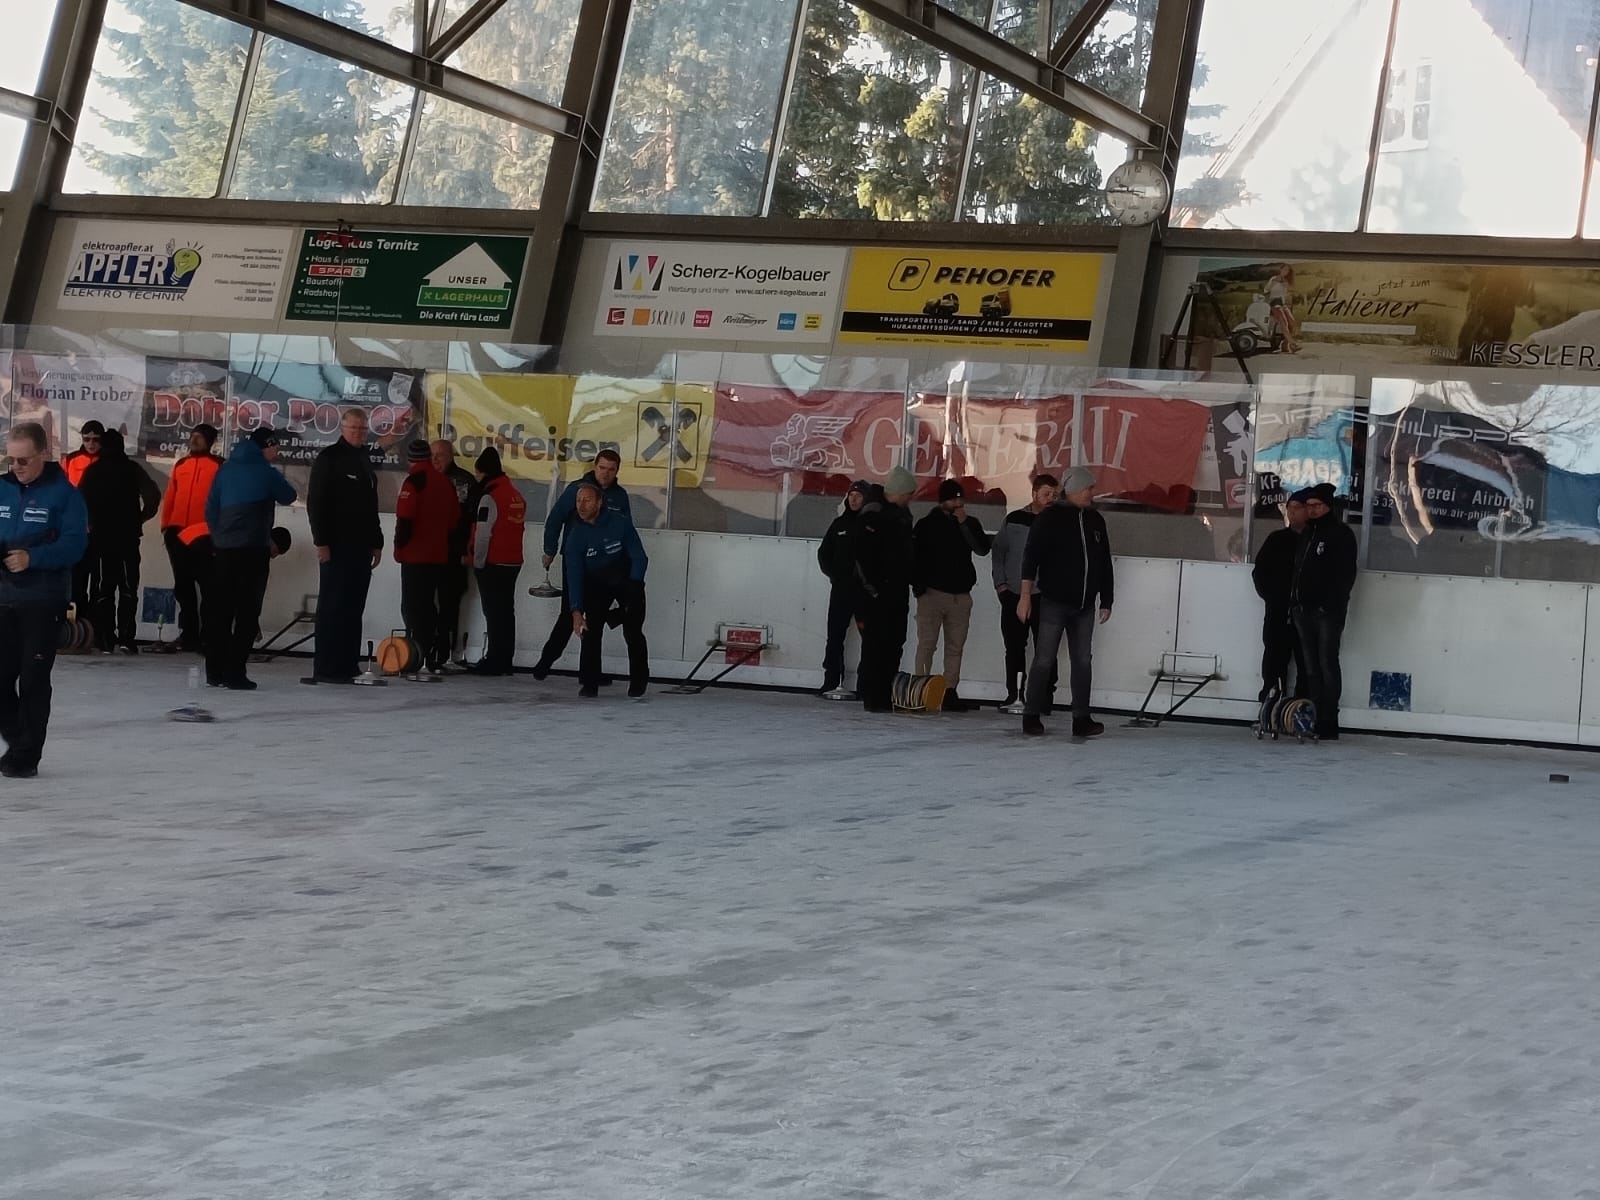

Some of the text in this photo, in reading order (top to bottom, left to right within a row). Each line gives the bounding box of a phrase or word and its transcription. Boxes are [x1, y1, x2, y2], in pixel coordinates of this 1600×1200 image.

[82, 241, 153, 253] elektroapfler.at
[377, 238, 420, 251] Ternitz
[311, 255, 332, 263] Haus
[69, 252, 169, 285] APFLER
[318, 267, 353, 275] SPAR
[671, 263, 831, 284] Scherz-Kogelbauer
[899, 265, 919, 283] P
[448, 275, 487, 285] UNSER
[933, 266, 1056, 288] PEHOFER
[63, 288, 185, 302] ELEKTRO TECHNIK
[303, 288, 338, 298] Radshop
[1374, 278, 1431, 297] jetzt zum
[434, 292, 504, 303] LAGERHAUS
[1307, 288, 1420, 319] Italiener
[435, 311, 458, 321] Kraft
[459, 312, 477, 321] fürs
[478, 313, 500, 322] Land
[20, 382, 134, 402] Florian Prober
[436, 422, 621, 463] Raiffeisen
[1374, 476, 1457, 502] Lackirerei
[1471, 488, 1536, 511] Airbruh
